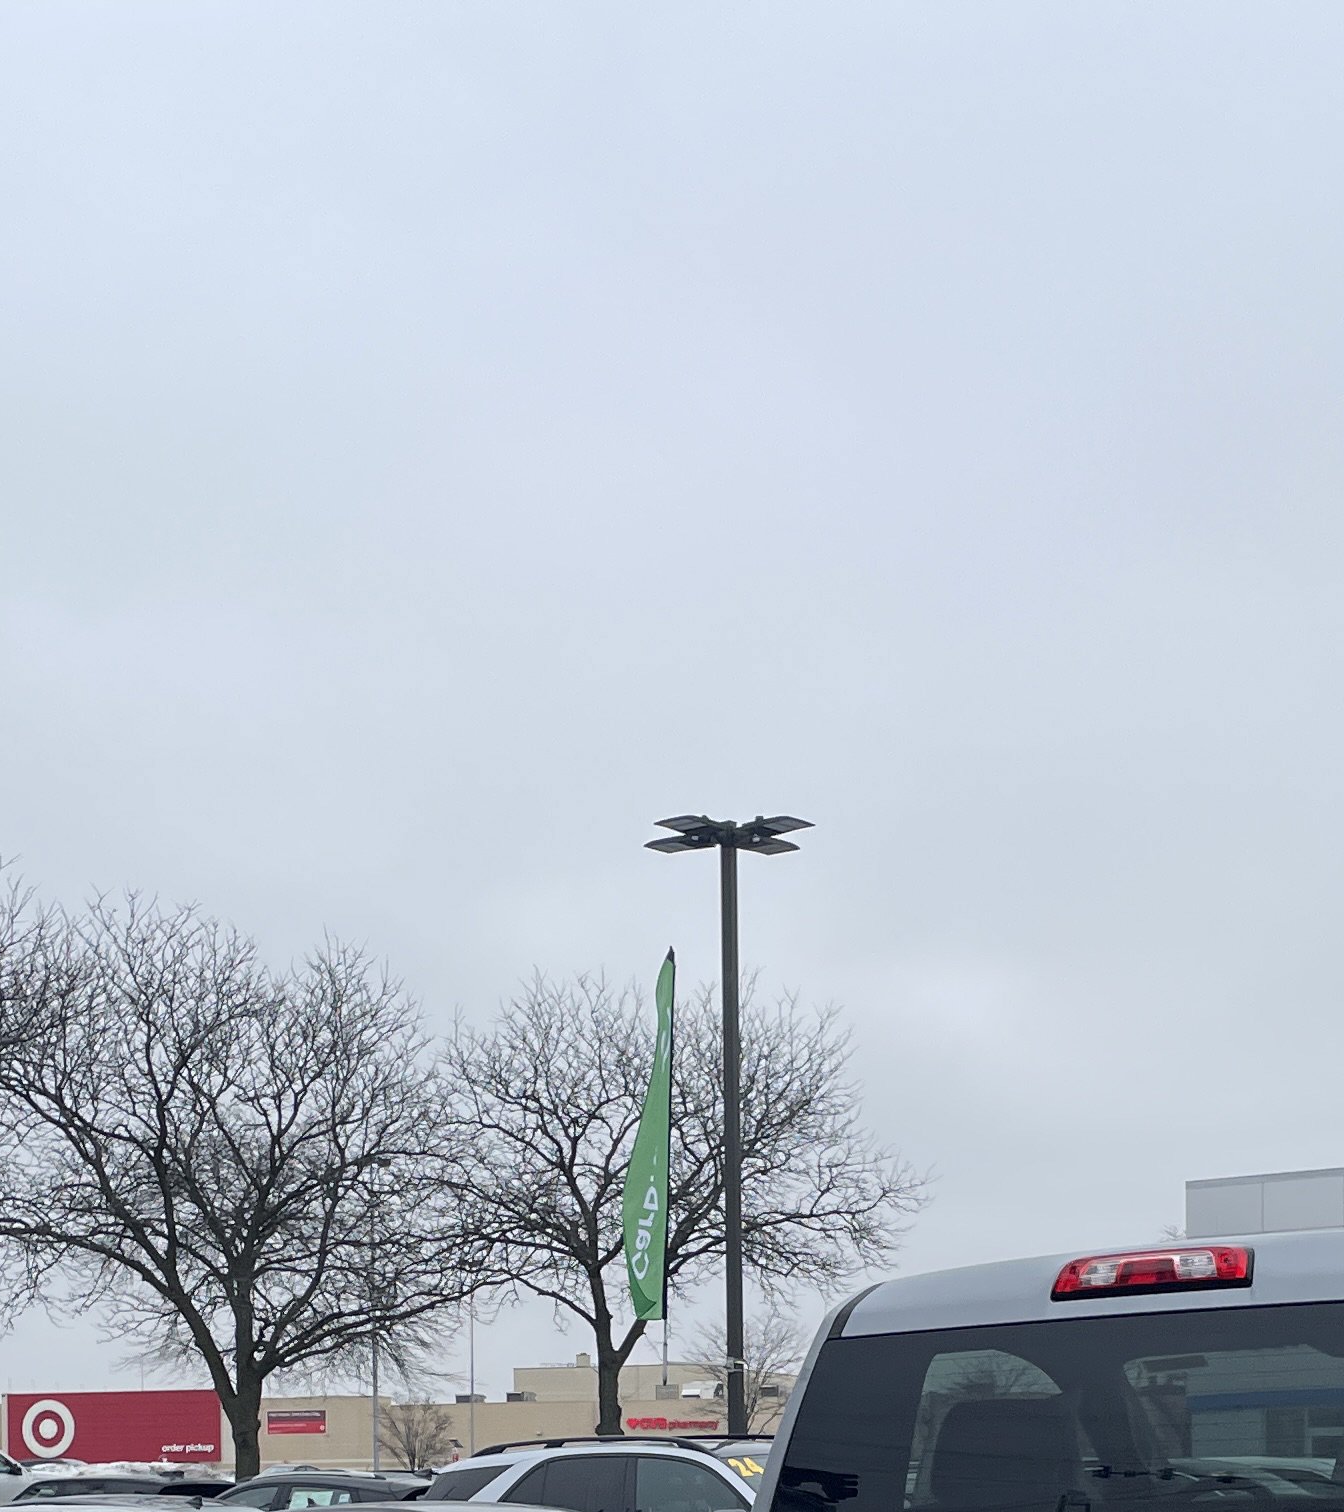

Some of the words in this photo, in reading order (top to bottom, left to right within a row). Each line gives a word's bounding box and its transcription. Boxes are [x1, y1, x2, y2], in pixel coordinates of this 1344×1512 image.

[161, 1443, 185, 1453] order
[185, 1443, 215, 1454] pickup
[727, 1457, 765, 1477] 24
